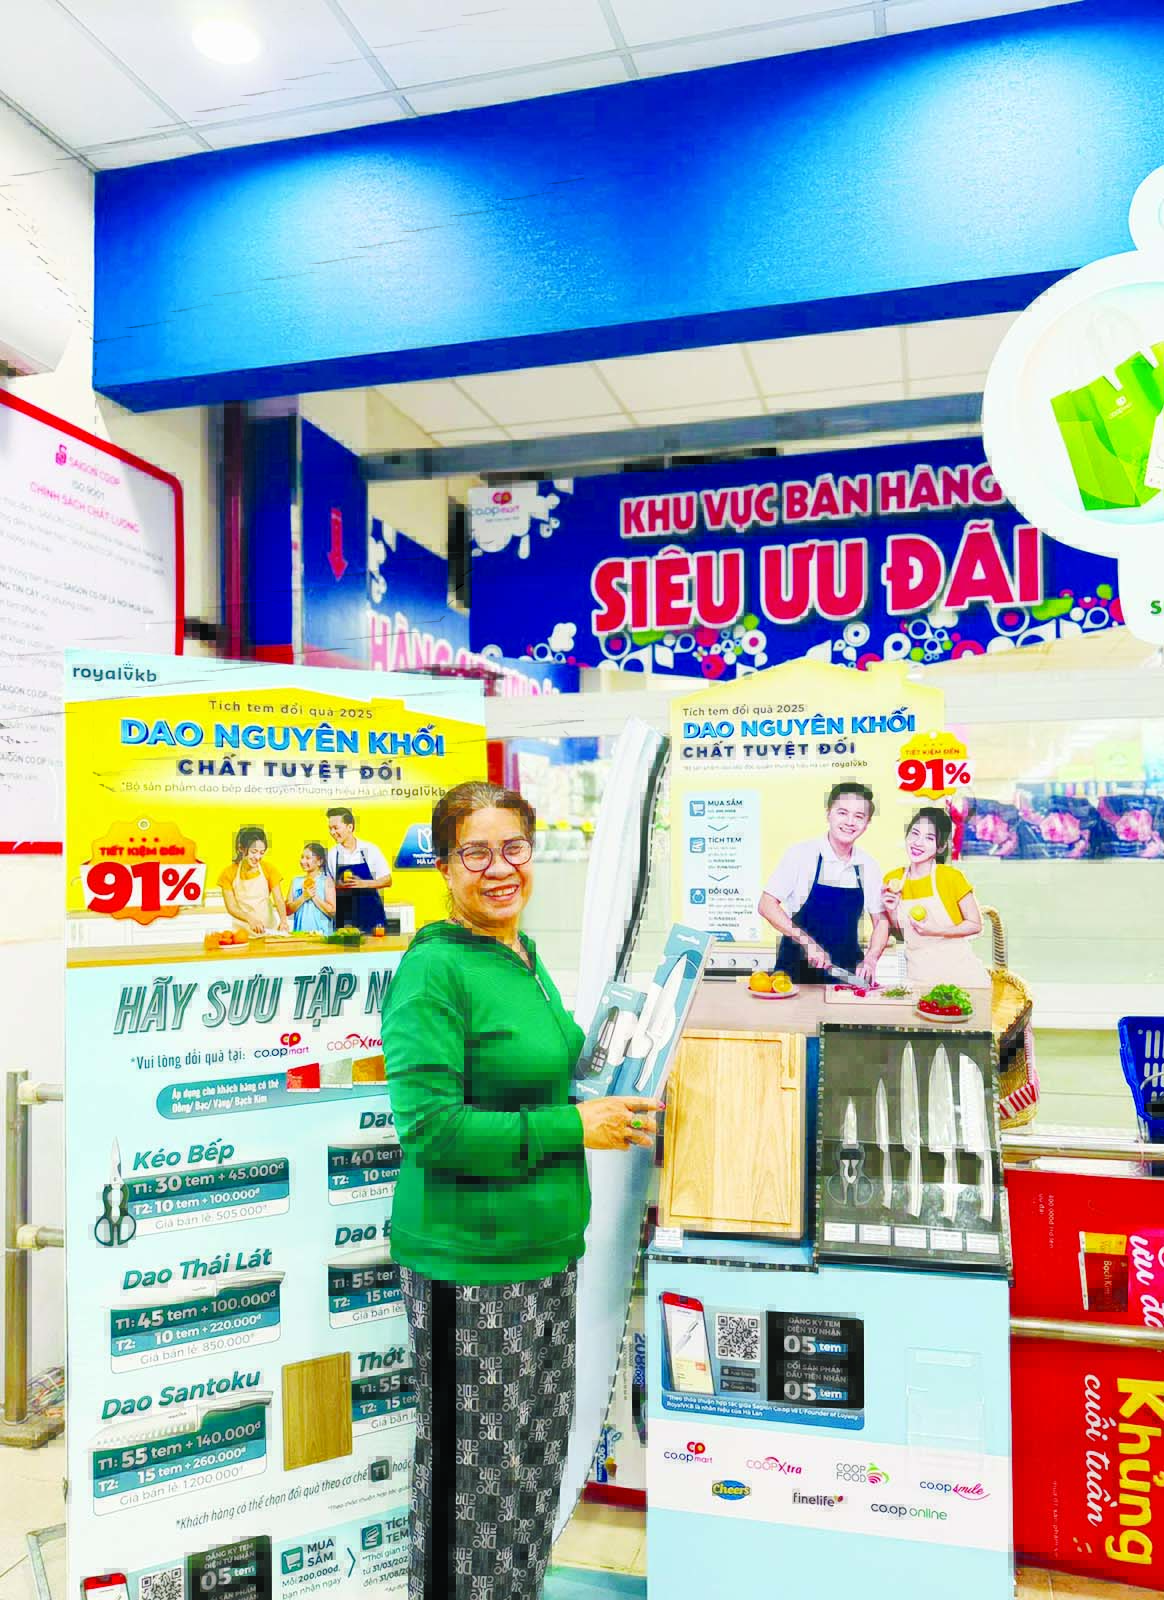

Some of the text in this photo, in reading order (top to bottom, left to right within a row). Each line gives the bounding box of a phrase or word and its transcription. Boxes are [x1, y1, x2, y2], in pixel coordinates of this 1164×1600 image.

[622, 465, 1004, 537] KHU VỰC BÁN HÀNG
[592, 521, 1039, 633] SIÊU ƯU ĐÃI
[209, 699, 241, 712] Tích
[247, 702, 274, 713] tem
[281, 701, 303, 715] đổi
[340, 708, 373, 719] 2025
[683, 707, 705, 717] Tích
[708, 705, 729, 716] tem
[732, 703, 750, 715] đổi
[777, 703, 805, 714] 2025
[683, 706, 916, 739] DAO NGUYÊN KHỐI
[120, 718, 445, 757] DAO NGUYÊN KHỐI
[683, 737, 855, 759] CHẤT TUYỆT ĐỐI
[922, 747, 942, 756] KIỆM
[178, 753, 402, 782] CHẤT TUYỆT ĐỐI
[898, 758, 971, 793] 91%
[199, 783, 219, 793] dao
[99, 844, 185, 858] TIẾT KIỆM ĐẾN
[86, 861, 201, 914] 91%
[113, 966, 358, 1035] HÃY SƯU TẬP
[158, 1053, 182, 1070] lòng
[202, 1086, 216, 1097] cho
[254, 1094, 268, 1104] Kim
[133, 1138, 235, 1171] Kéo Bếp
[332, 1149, 403, 1166] T1: 40 tem
[133, 1184, 152, 1195] T1:
[155, 1176, 182, 1194] 30
[185, 1174, 215, 1188] tem
[332, 1169, 380, 1186] T2: 10
[133, 1199, 200, 1216] T2: 10 tem
[155, 1215, 199, 1230] Giá bán
[334, 1225, 377, 1246] Dao
[122, 1248, 272, 1290] Dao Thái Lát
[333, 1271, 375, 1289] T1: 55
[333, 1289, 381, 1309] T2: 15
[115, 1317, 136, 1331] T1:
[137, 1309, 164, 1329] 45
[166, 1306, 198, 1322] tem
[788, 1316, 841, 1328] ĐĂNG TEM
[116, 1326, 199, 1352] T2: 10 tem
[784, 1335, 842, 1355] 05 tem
[140, 1347, 185, 1366] Giá bán
[358, 1347, 406, 1373] Thớt
[360, 1374, 400, 1395] T1: 55
[784, 1380, 843, 1401] 05 tem
[101, 1371, 261, 1421] Dao Santoku
[360, 1396, 400, 1414] T2: 15
[98, 1457, 118, 1471] T1:
[121, 1447, 148, 1469] 55
[151, 1442, 182, 1459] tem
[1084, 1374, 1119, 1528] cuối tuần
[98, 1464, 183, 1492] T2: 15 tem
[836, 1472, 866, 1483] FOOD
[1105, 1377, 1164, 1565] Khủng
[119, 1487, 165, 1506] Giá bán
[211, 1465, 386, 1522] hàng có thể chọn đổi theo chế T1
[712, 1481, 751, 1497] Cheers
[793, 1492, 835, 1507] finelife
[909, 1506, 948, 1521] online
[239, 1542, 254, 1552] TEM
[307, 1538, 335, 1554] MUA
[307, 1551, 334, 1567] SẮM
[201, 1565, 256, 1590] 05 tem
